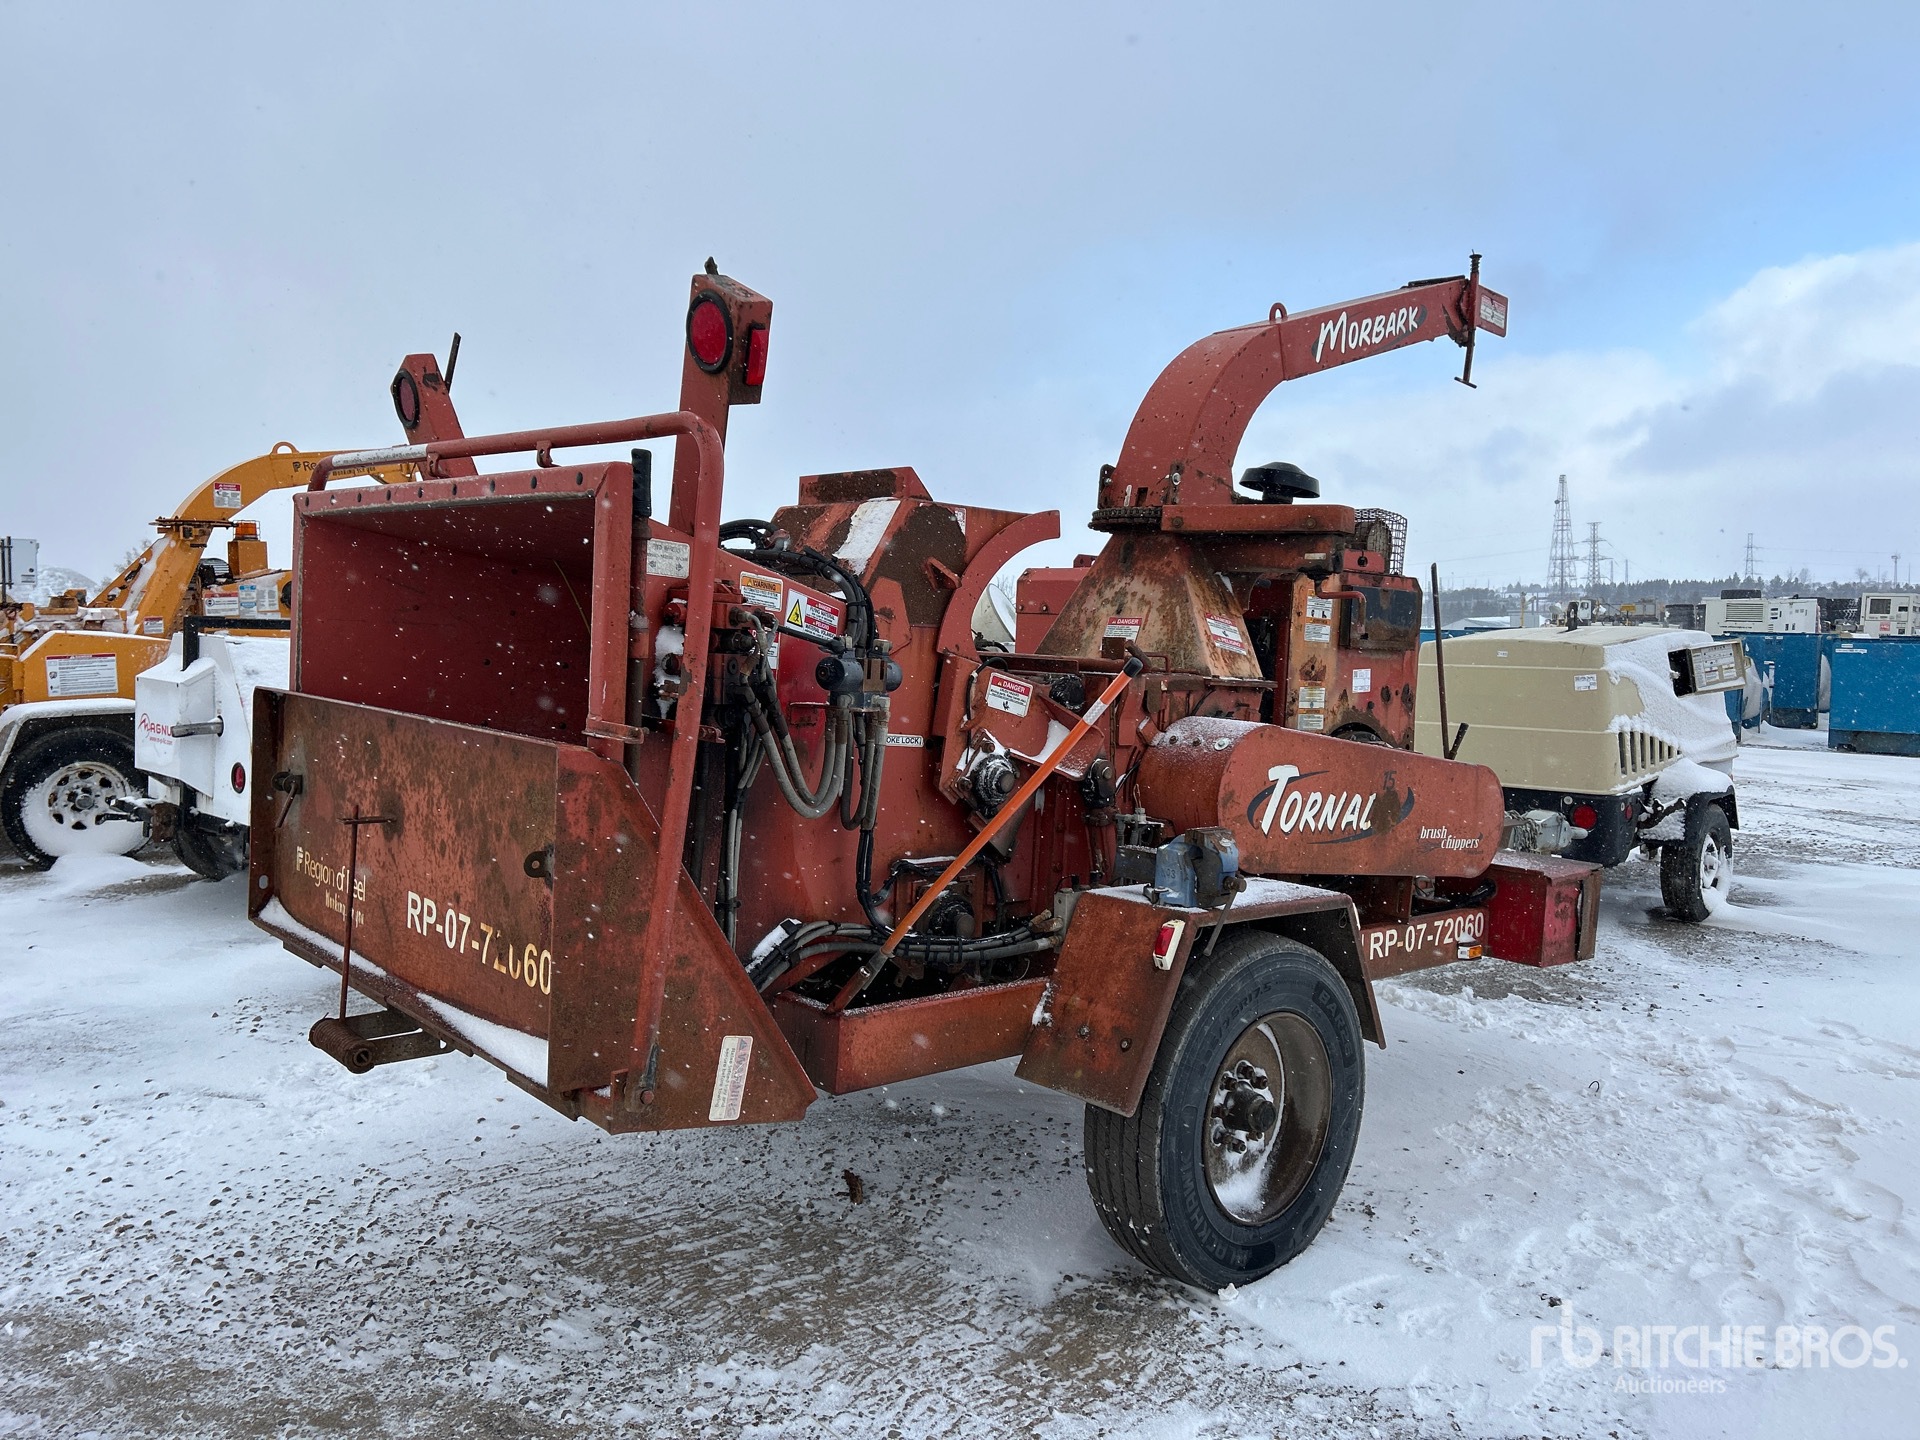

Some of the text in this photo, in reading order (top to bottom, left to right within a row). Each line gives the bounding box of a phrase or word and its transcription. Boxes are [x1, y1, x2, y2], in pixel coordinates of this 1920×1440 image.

[1315, 306, 1419, 363] MORBARK
[753, 580, 776, 591] WARNING
[1003, 681, 1025, 693] DANGER
[138, 713, 173, 737] MAGNU
[1382, 770, 1397, 791] 15
[1420, 826, 1448, 840] brush
[1441, 834, 1480, 851] chippers
[304, 851, 335, 887] Region
[336, 865, 346, 892] of
[1369, 912, 1484, 960] RP-07-72060
[718, 1068, 726, 1087] before
